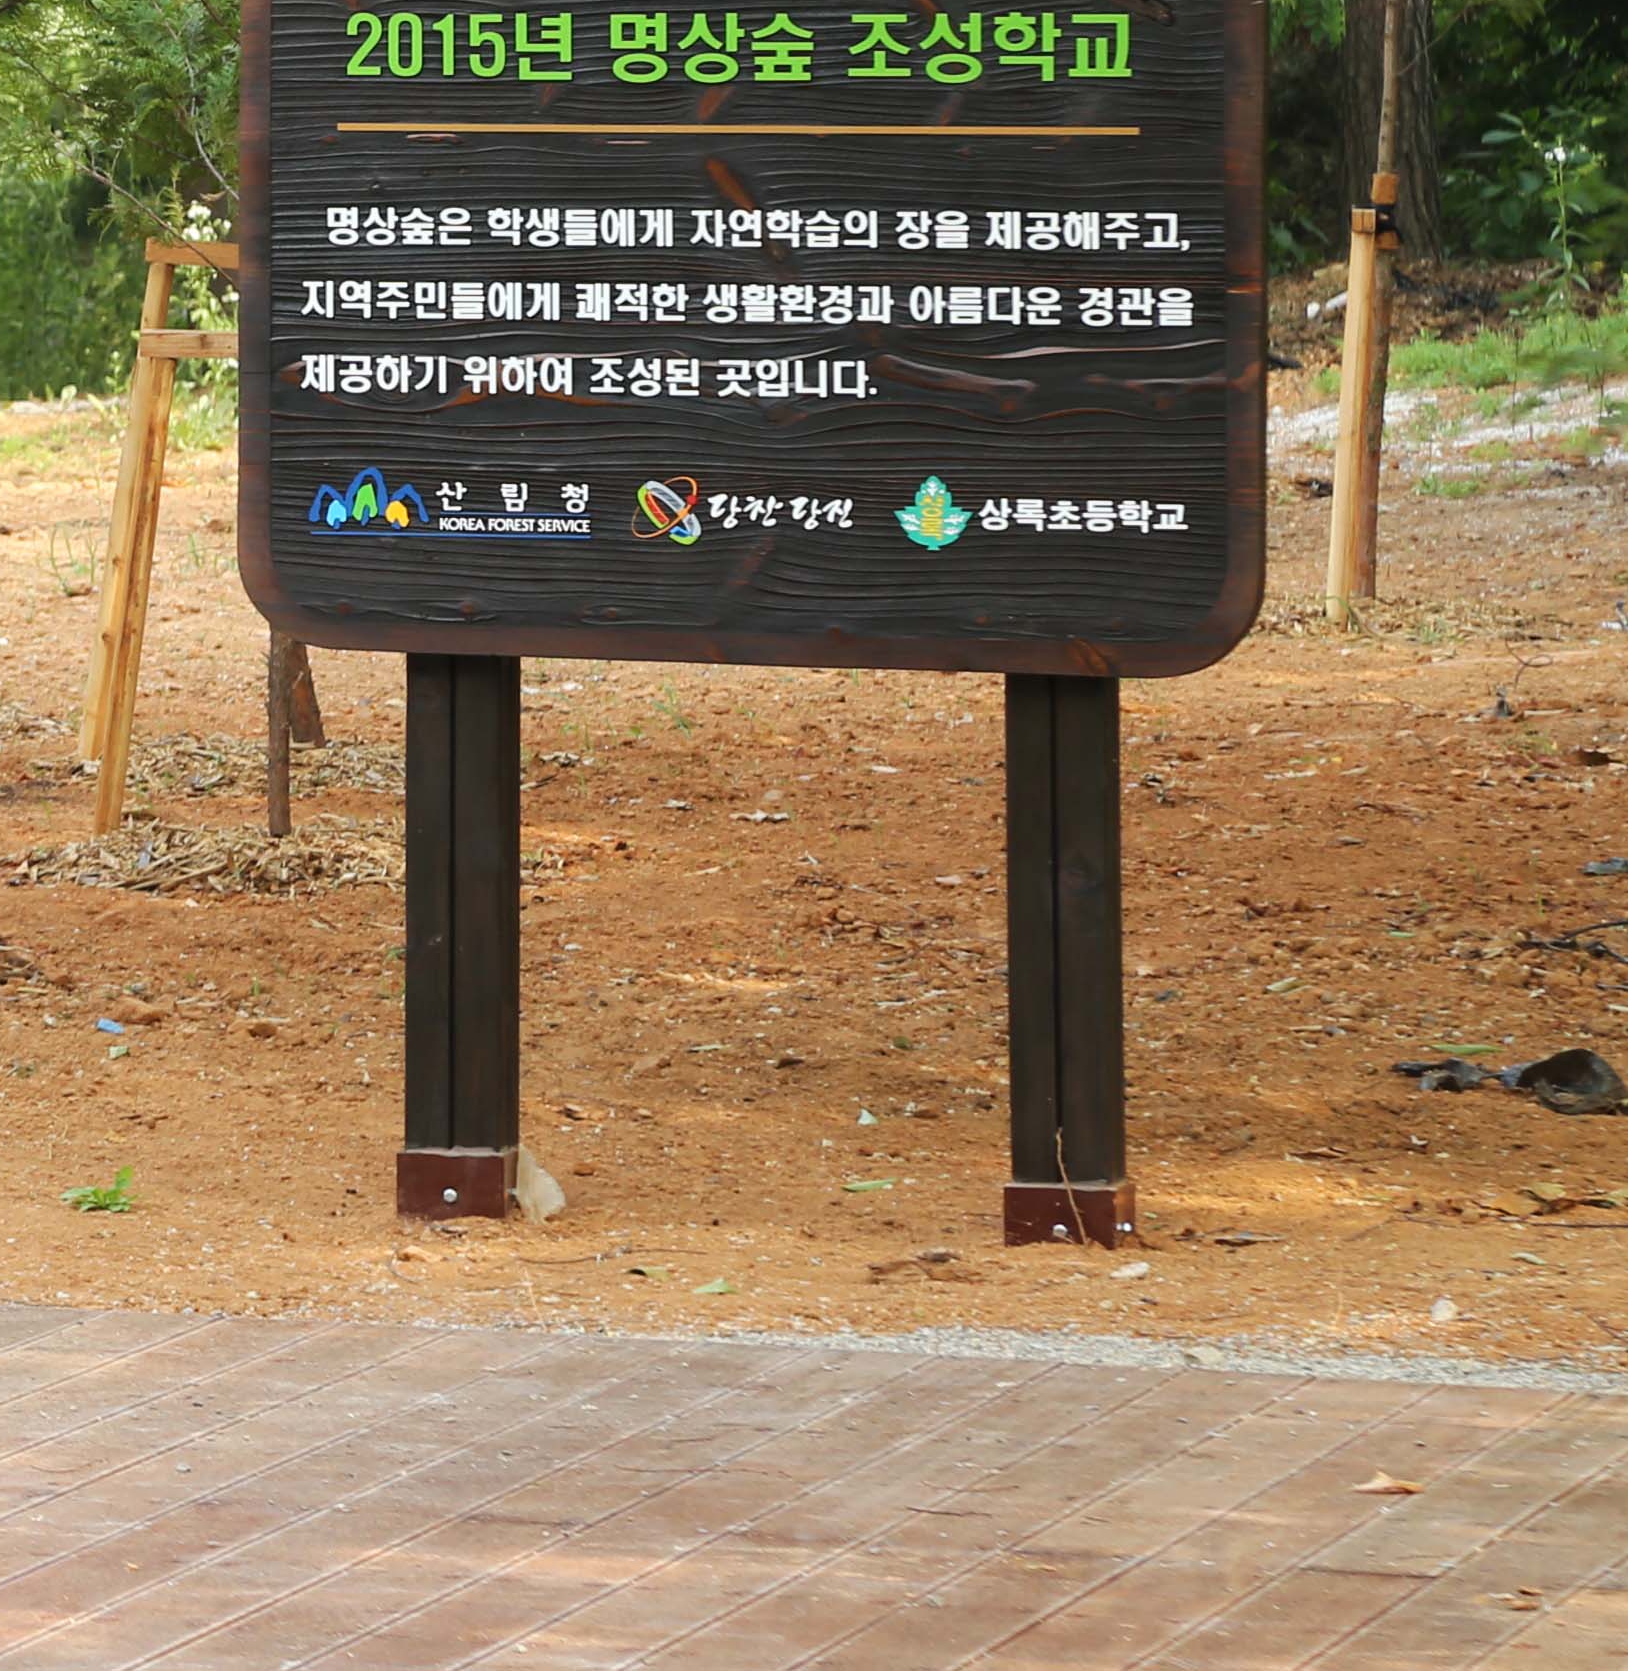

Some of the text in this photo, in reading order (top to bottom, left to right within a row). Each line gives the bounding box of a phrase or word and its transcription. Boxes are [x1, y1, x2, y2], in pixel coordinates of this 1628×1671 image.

[346, 12, 1132, 84] 2015년 명상숲 조성학교
[326, 206, 1190, 251] 명상숲은 학생들에게 자연학습의 장을 제공해주고,
[301, 280, 1194, 327] 지역주민들에게 쾌적한 생활환경과 아름다운 경관을
[300, 353, 878, 399] 제공하기 위하여 조성된 곳입니다.
[439, 517, 591, 533] KOREA FOREST SERVICE
[978, 497, 1189, 534] 상록초등학교
